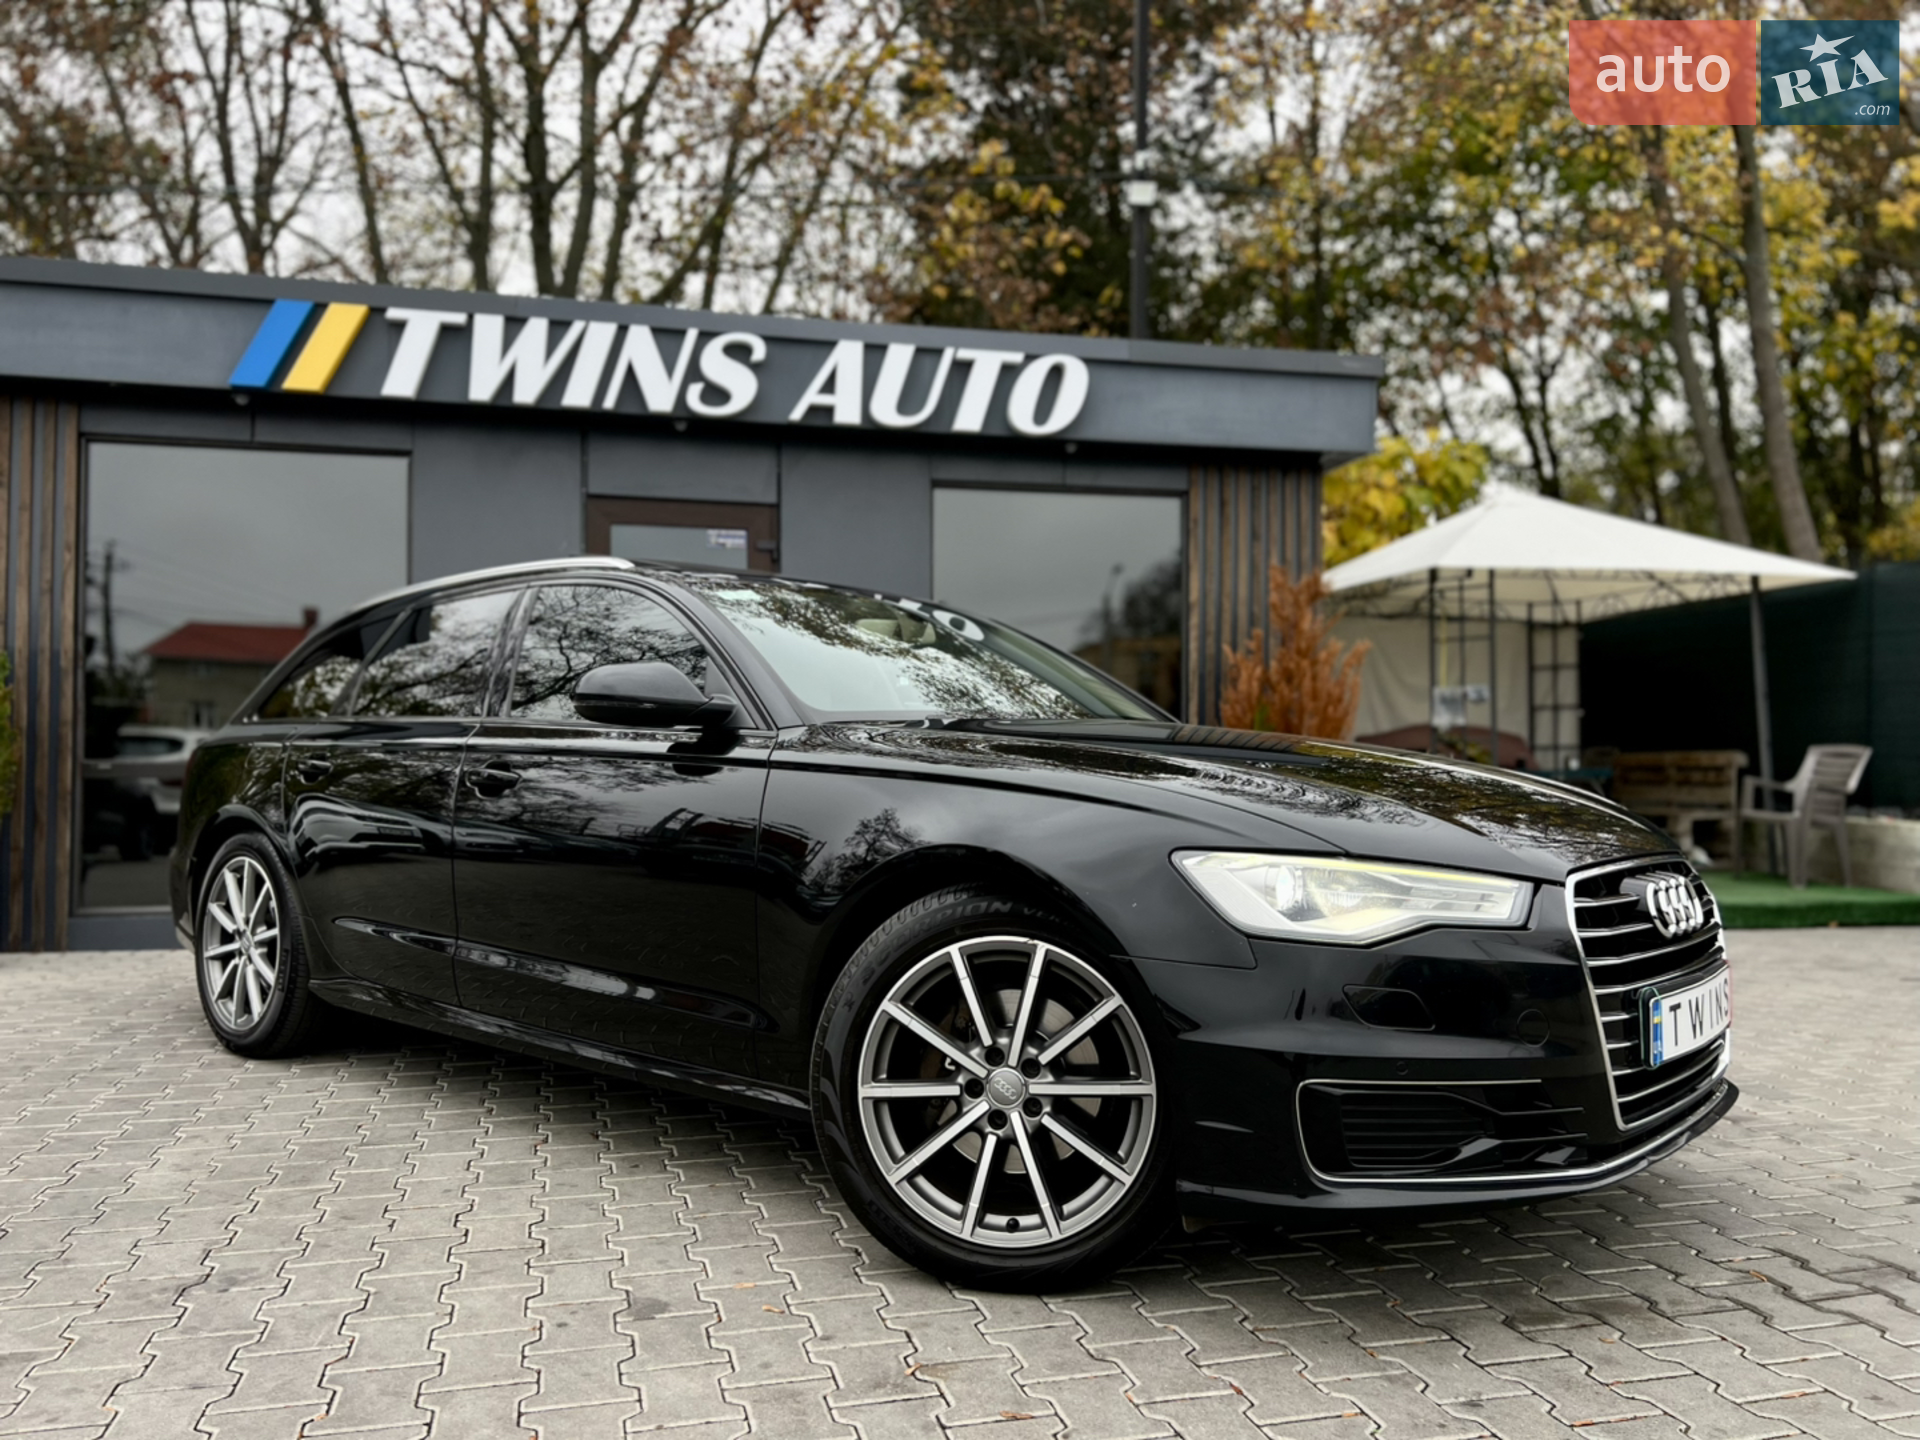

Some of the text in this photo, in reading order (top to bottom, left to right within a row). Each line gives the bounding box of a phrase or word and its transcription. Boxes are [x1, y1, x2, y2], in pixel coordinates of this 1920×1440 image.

[379, 306, 1090, 437] TWINS AUTO
[1669, 977, 1729, 1047] TWINS
